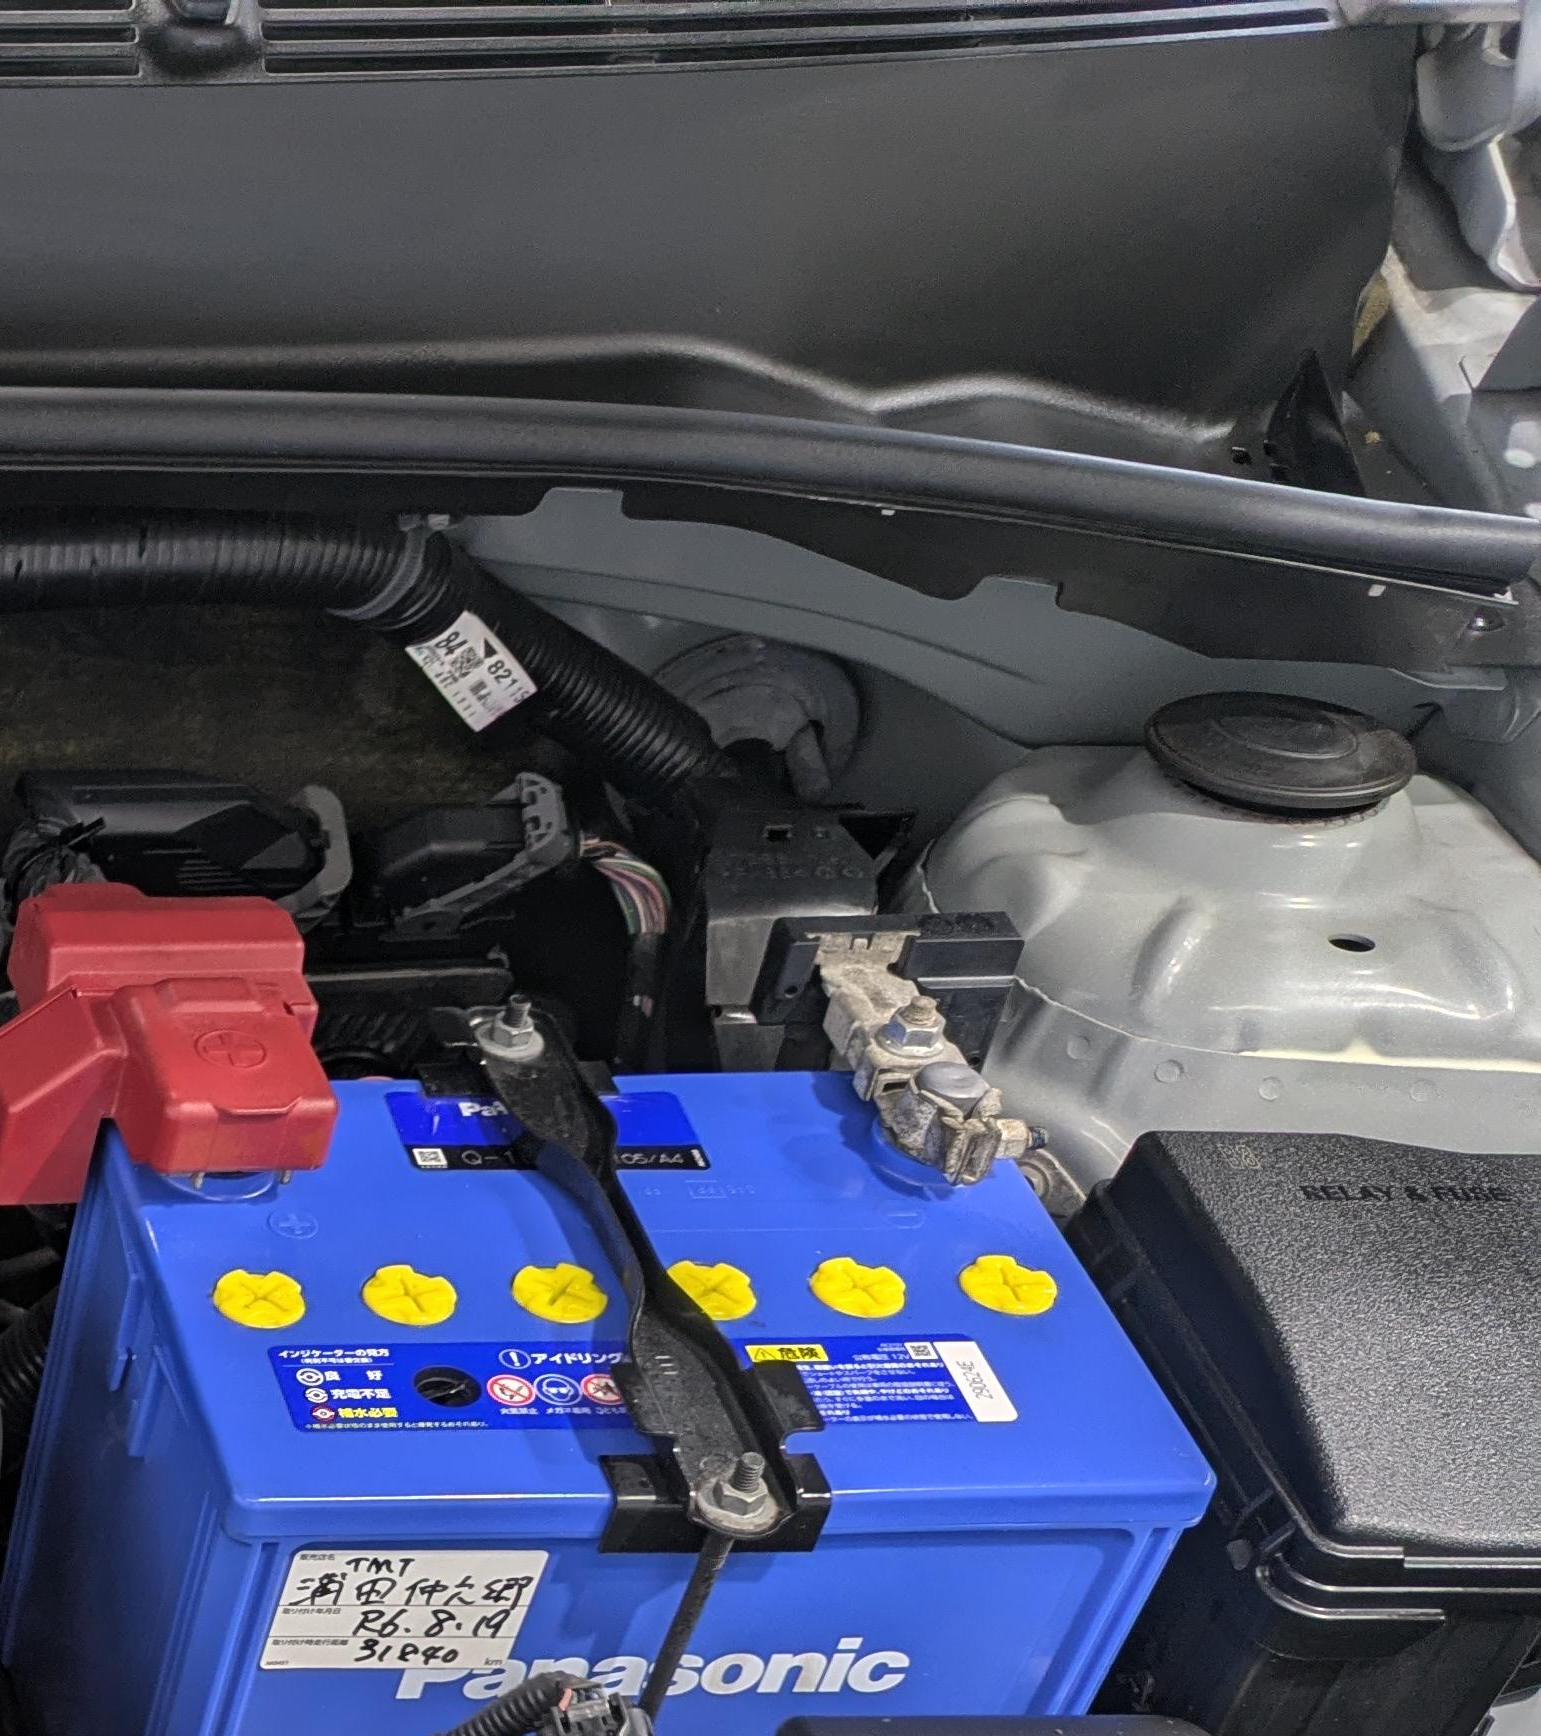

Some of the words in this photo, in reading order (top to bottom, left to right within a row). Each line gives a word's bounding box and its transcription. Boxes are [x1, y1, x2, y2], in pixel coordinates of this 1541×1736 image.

[1300, 1184, 1392, 1202] RELAY
[777, 1347, 822, 1361] 危険
[345, 1557, 416, 1577] TMT
[483, 1657, 504, 1667] km
